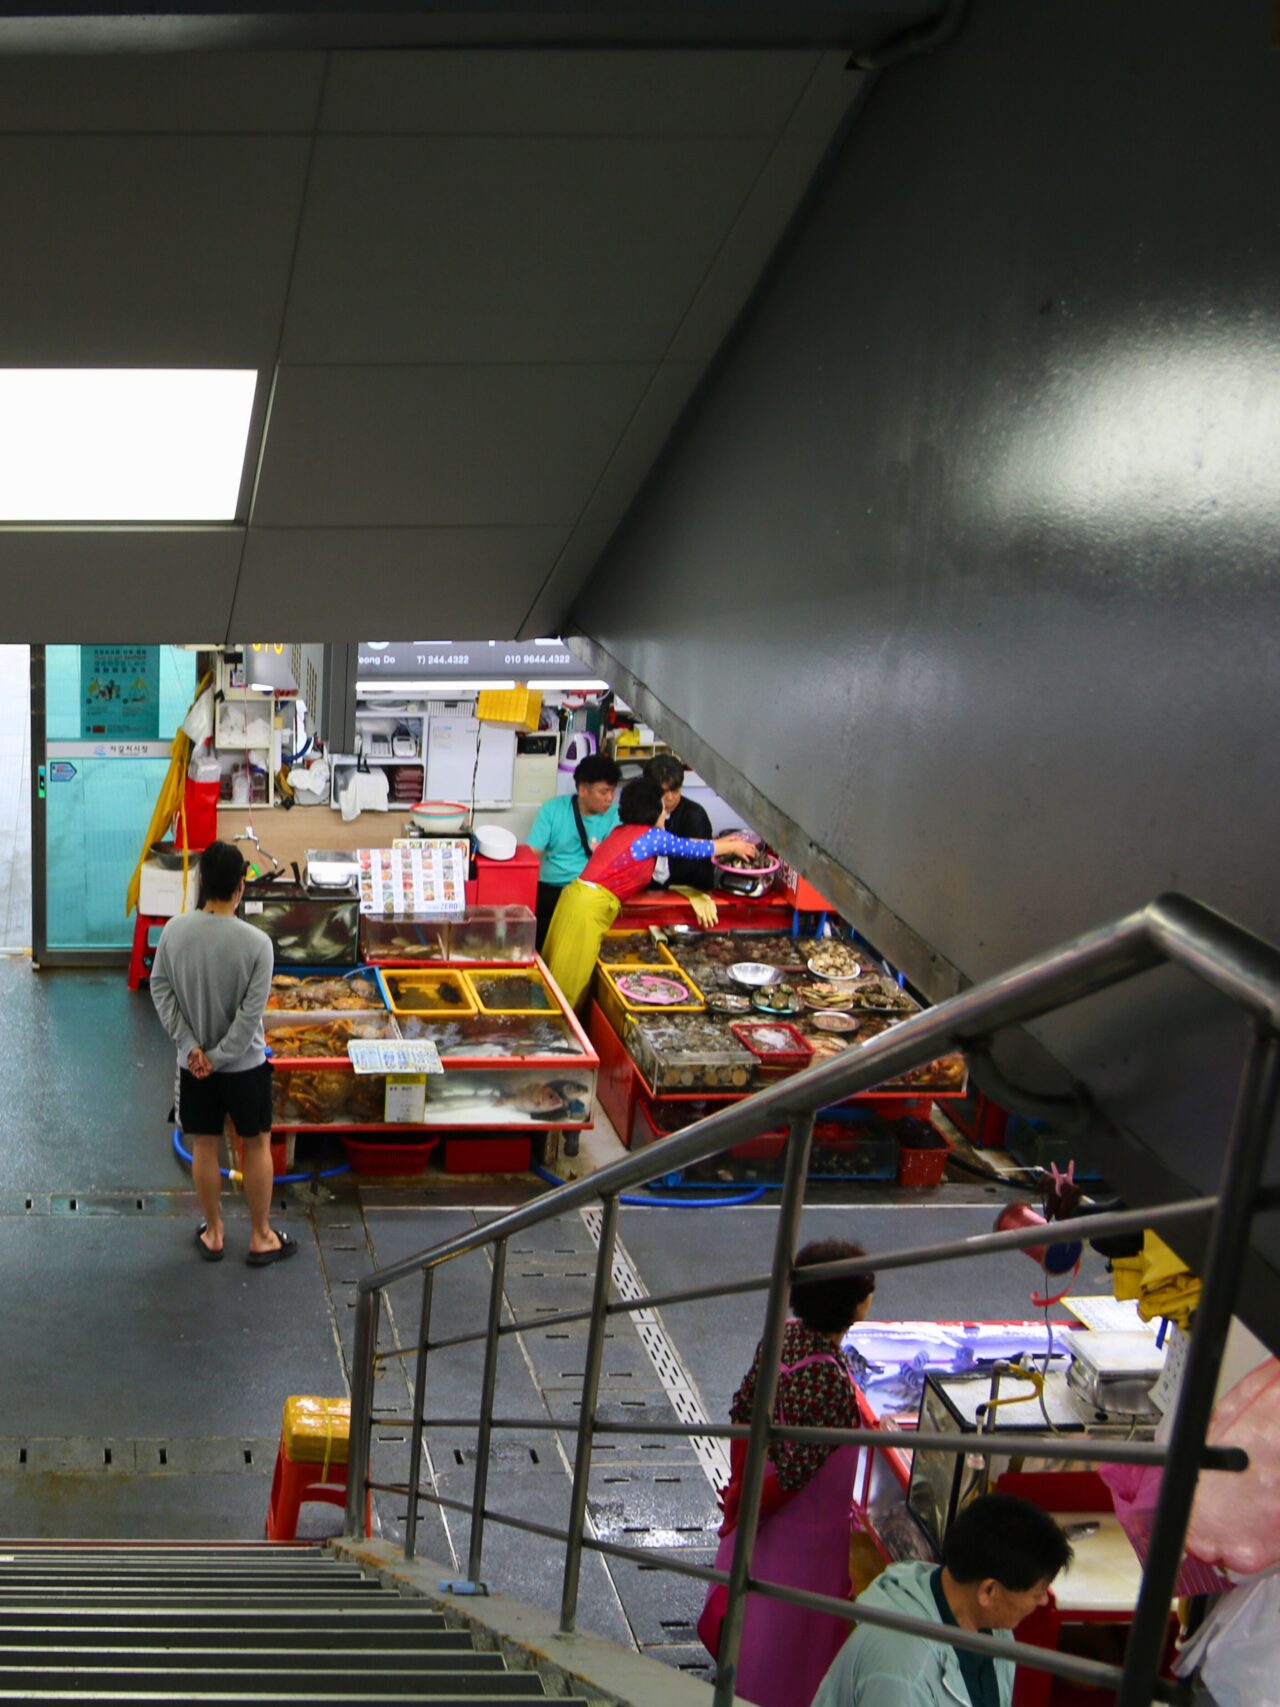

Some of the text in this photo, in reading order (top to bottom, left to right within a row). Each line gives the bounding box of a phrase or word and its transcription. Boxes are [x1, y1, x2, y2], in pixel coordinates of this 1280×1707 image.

[358, 655, 381, 666] eong
[383, 655, 396, 665] Do
[505, 654, 521, 665] 010
